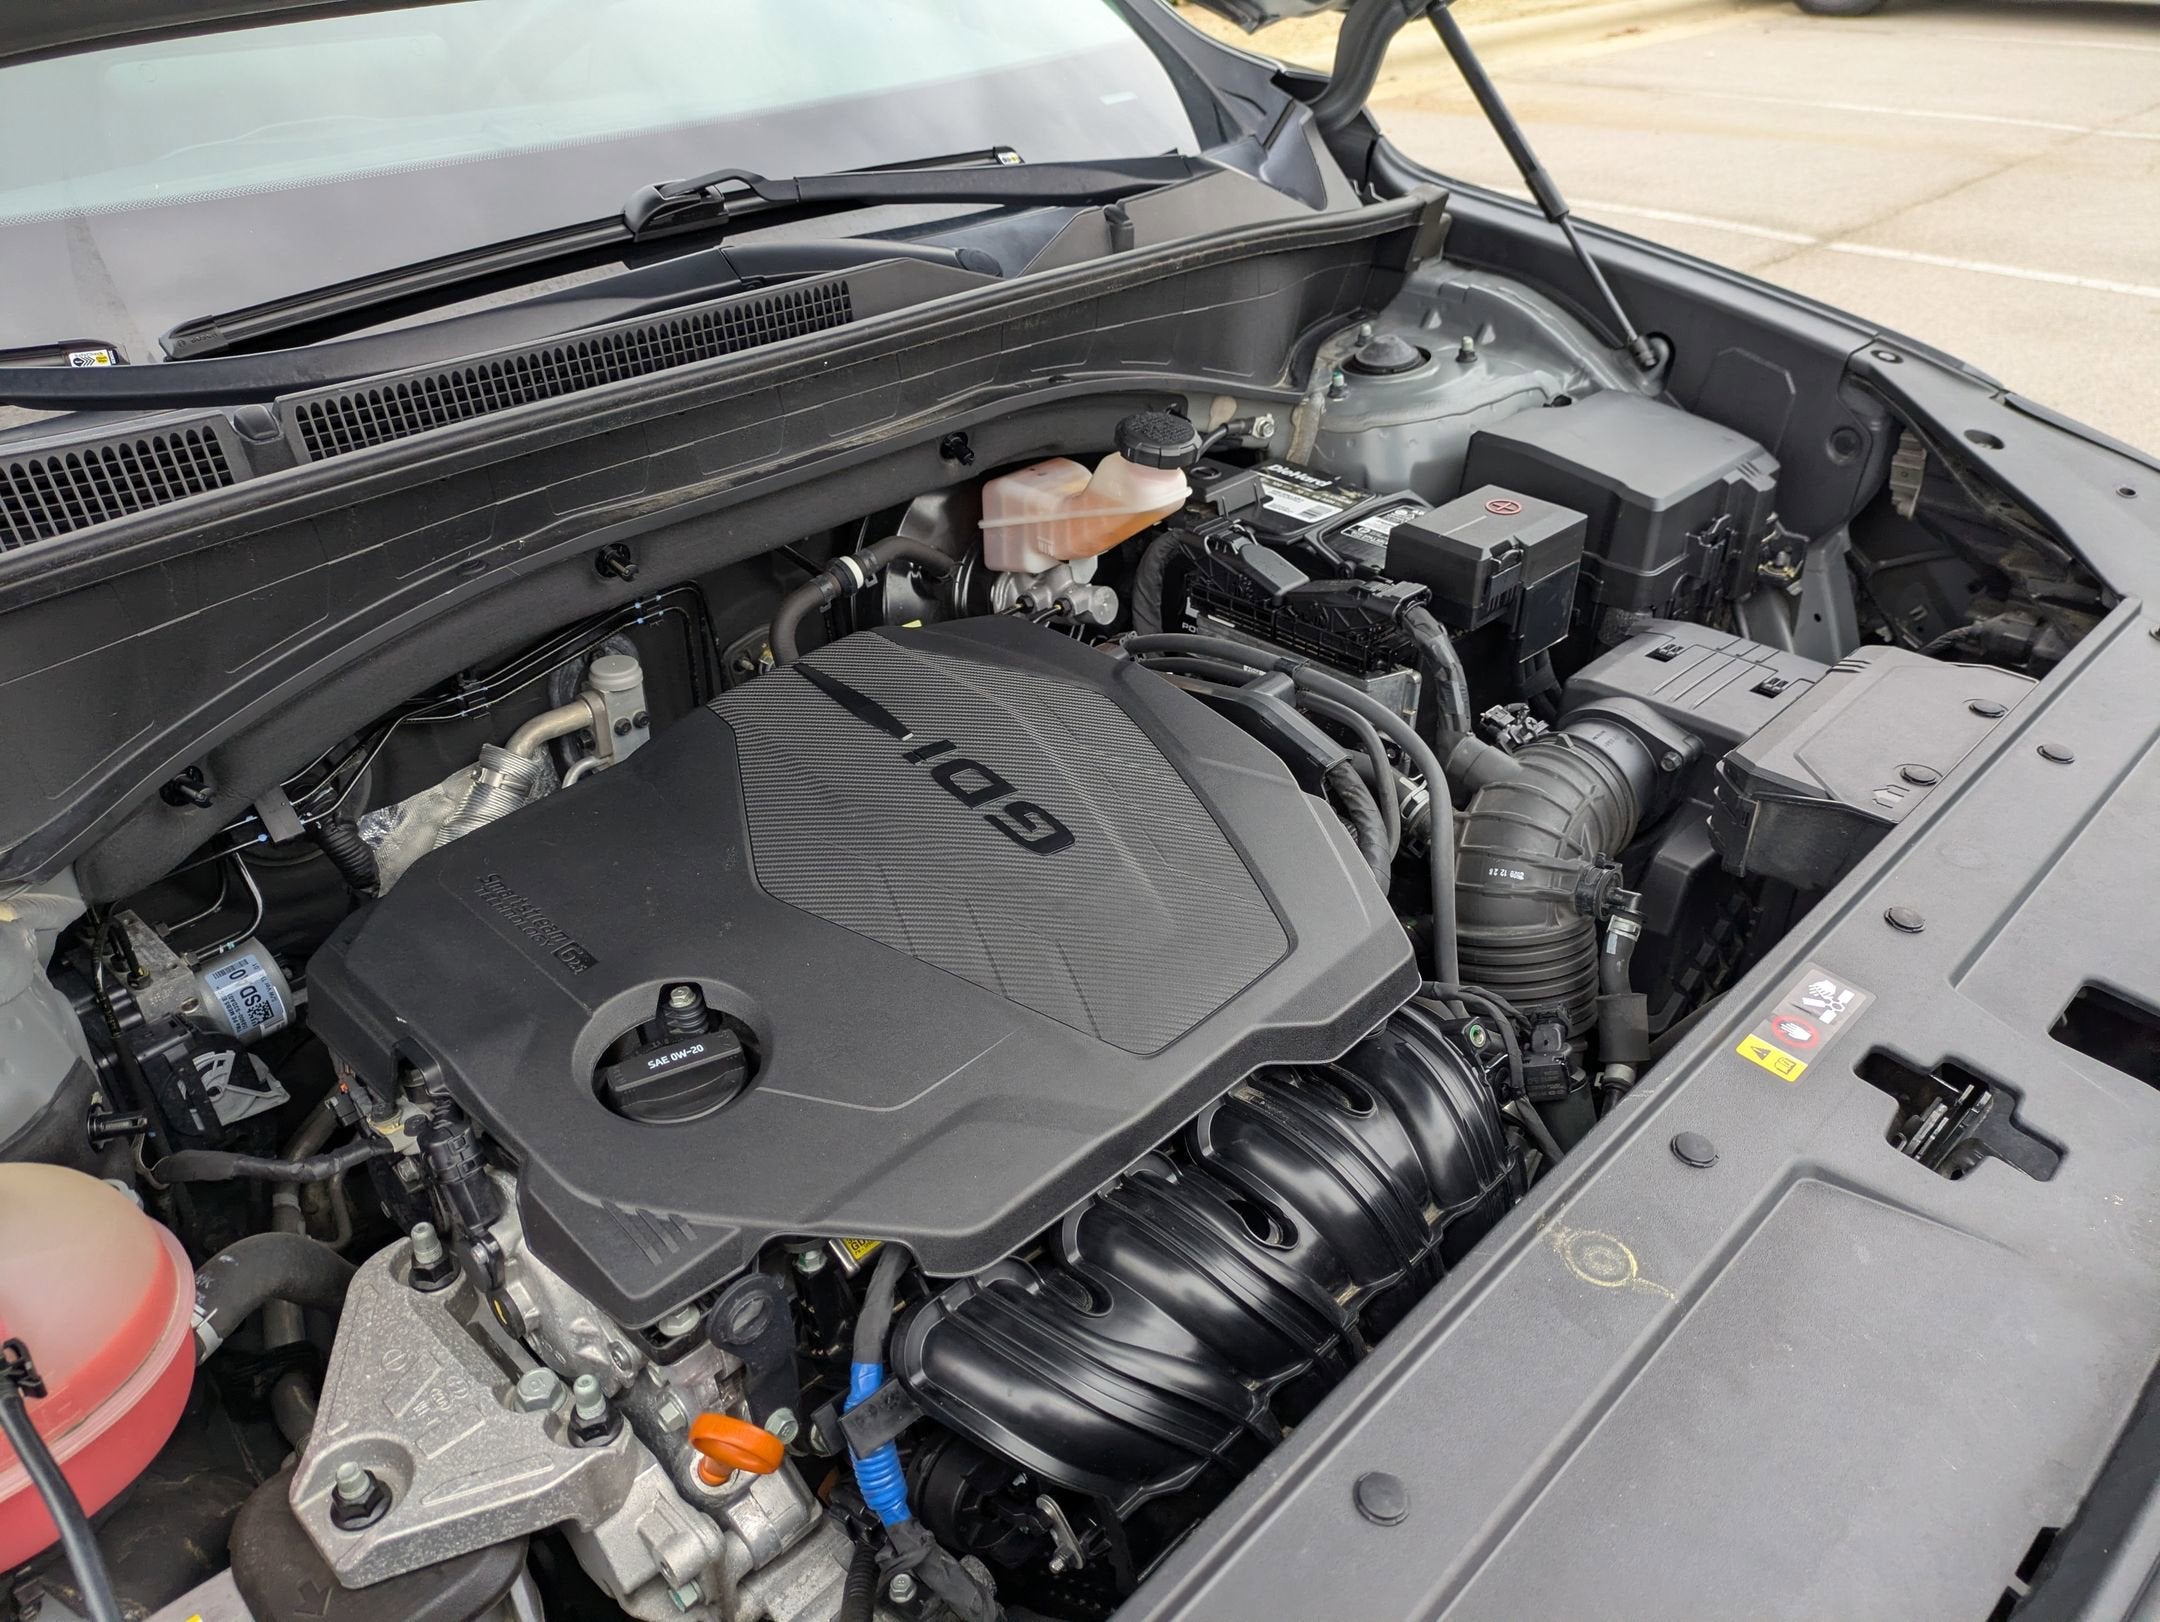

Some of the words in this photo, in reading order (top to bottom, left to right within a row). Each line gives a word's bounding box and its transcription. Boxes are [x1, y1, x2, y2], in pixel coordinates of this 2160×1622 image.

[1267, 464, 1333, 487] DieHard
[902, 739, 1076, 857] GDI
[474, 887, 556, 947] TECHNOLOGY
[477, 873, 569, 943] Smartstream
[647, 1057, 670, 1070] SAE
[670, 1044, 704, 1061] 0W-20
